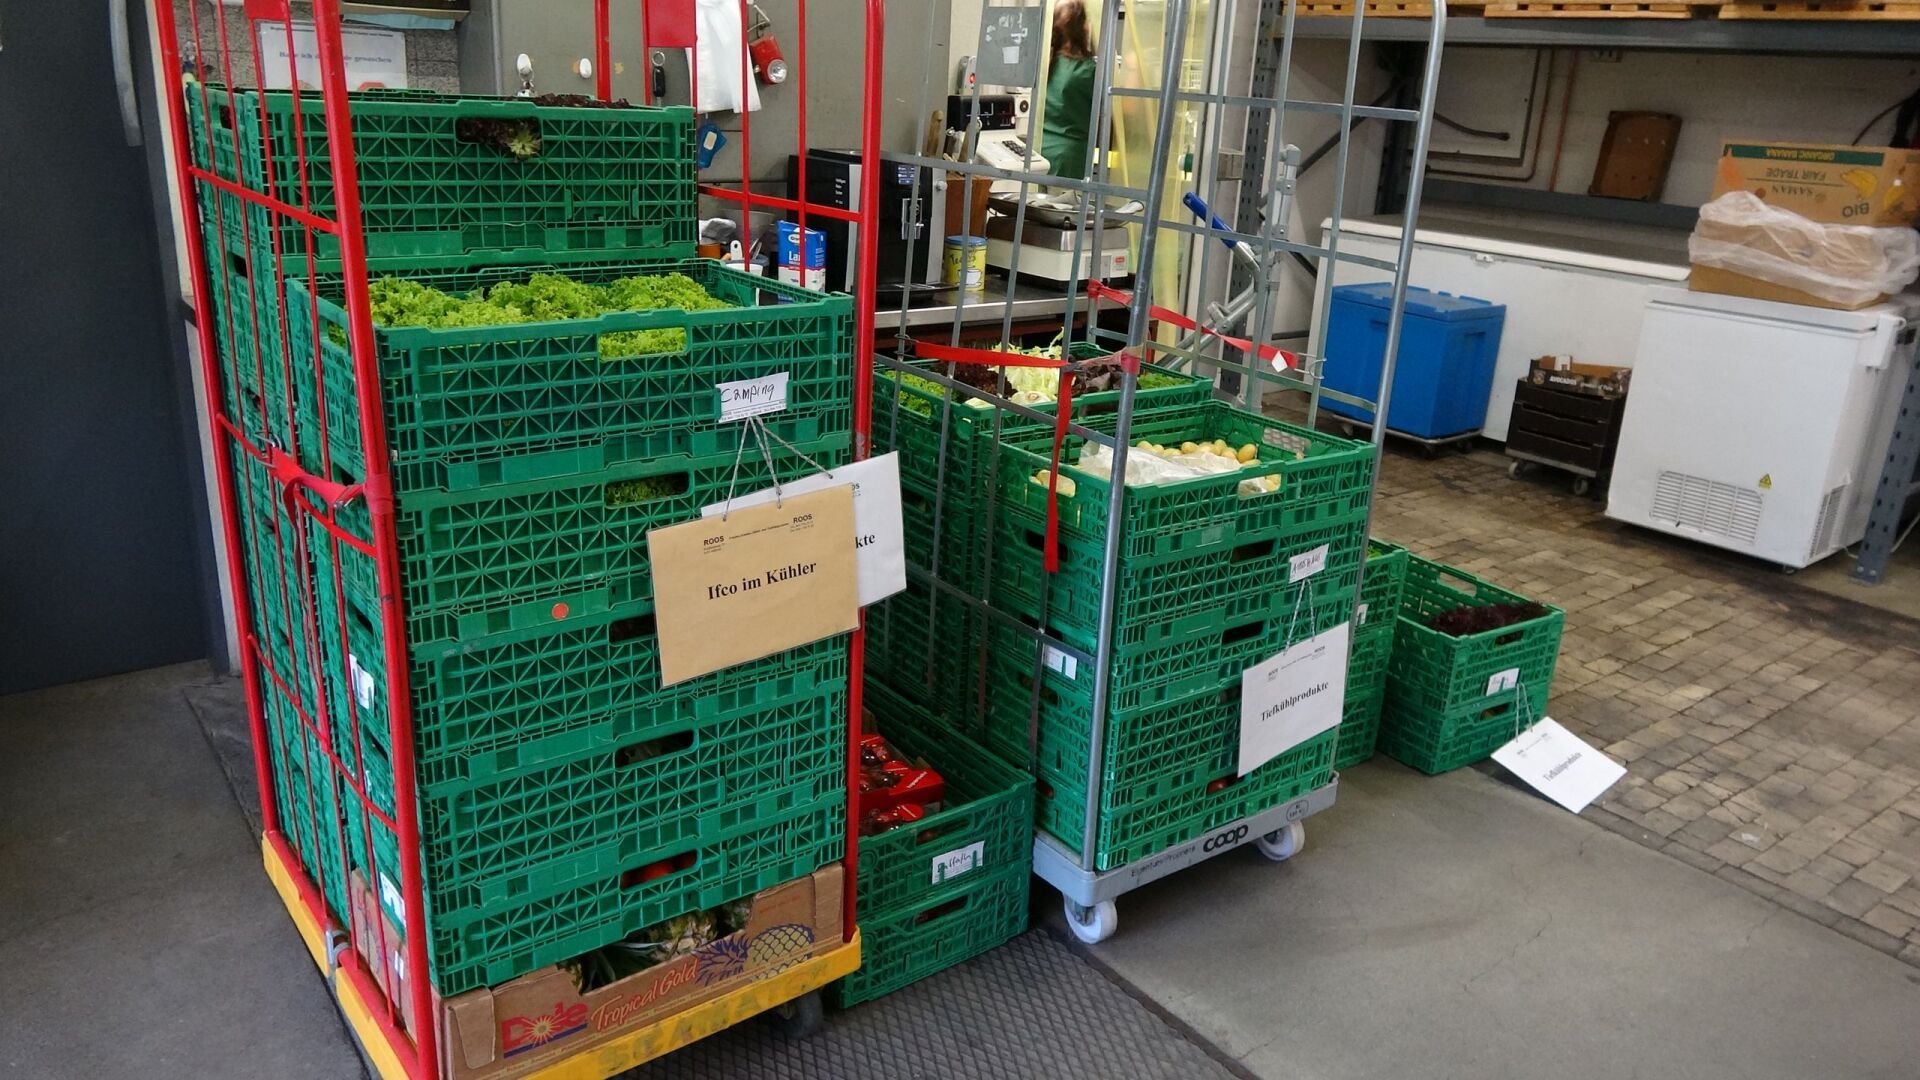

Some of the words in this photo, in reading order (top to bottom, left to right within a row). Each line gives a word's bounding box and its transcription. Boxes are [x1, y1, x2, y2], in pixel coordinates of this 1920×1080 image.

[1799, 151, 1835, 161] ORGANIC
[1766, 167, 1799, 180] TRADE
[1802, 170, 1826, 182] FAIR
[1771, 184, 1814, 198] SAMAN
[1842, 202, 1870, 218] BIO
[721, 383, 775, 404] Camping
[793, 513, 813, 524] ROOS
[703, 535, 725, 546] ROOS
[708, 584, 738, 600] Ifco
[742, 577, 761, 591] im
[766, 562, 817, 585] Kühler
[1261, 681, 1329, 721] Tiefkühlprodukte
[1203, 824, 1249, 852] coop
[591, 979, 658, 1031] Tropical
[659, 958, 699, 998] Gold
